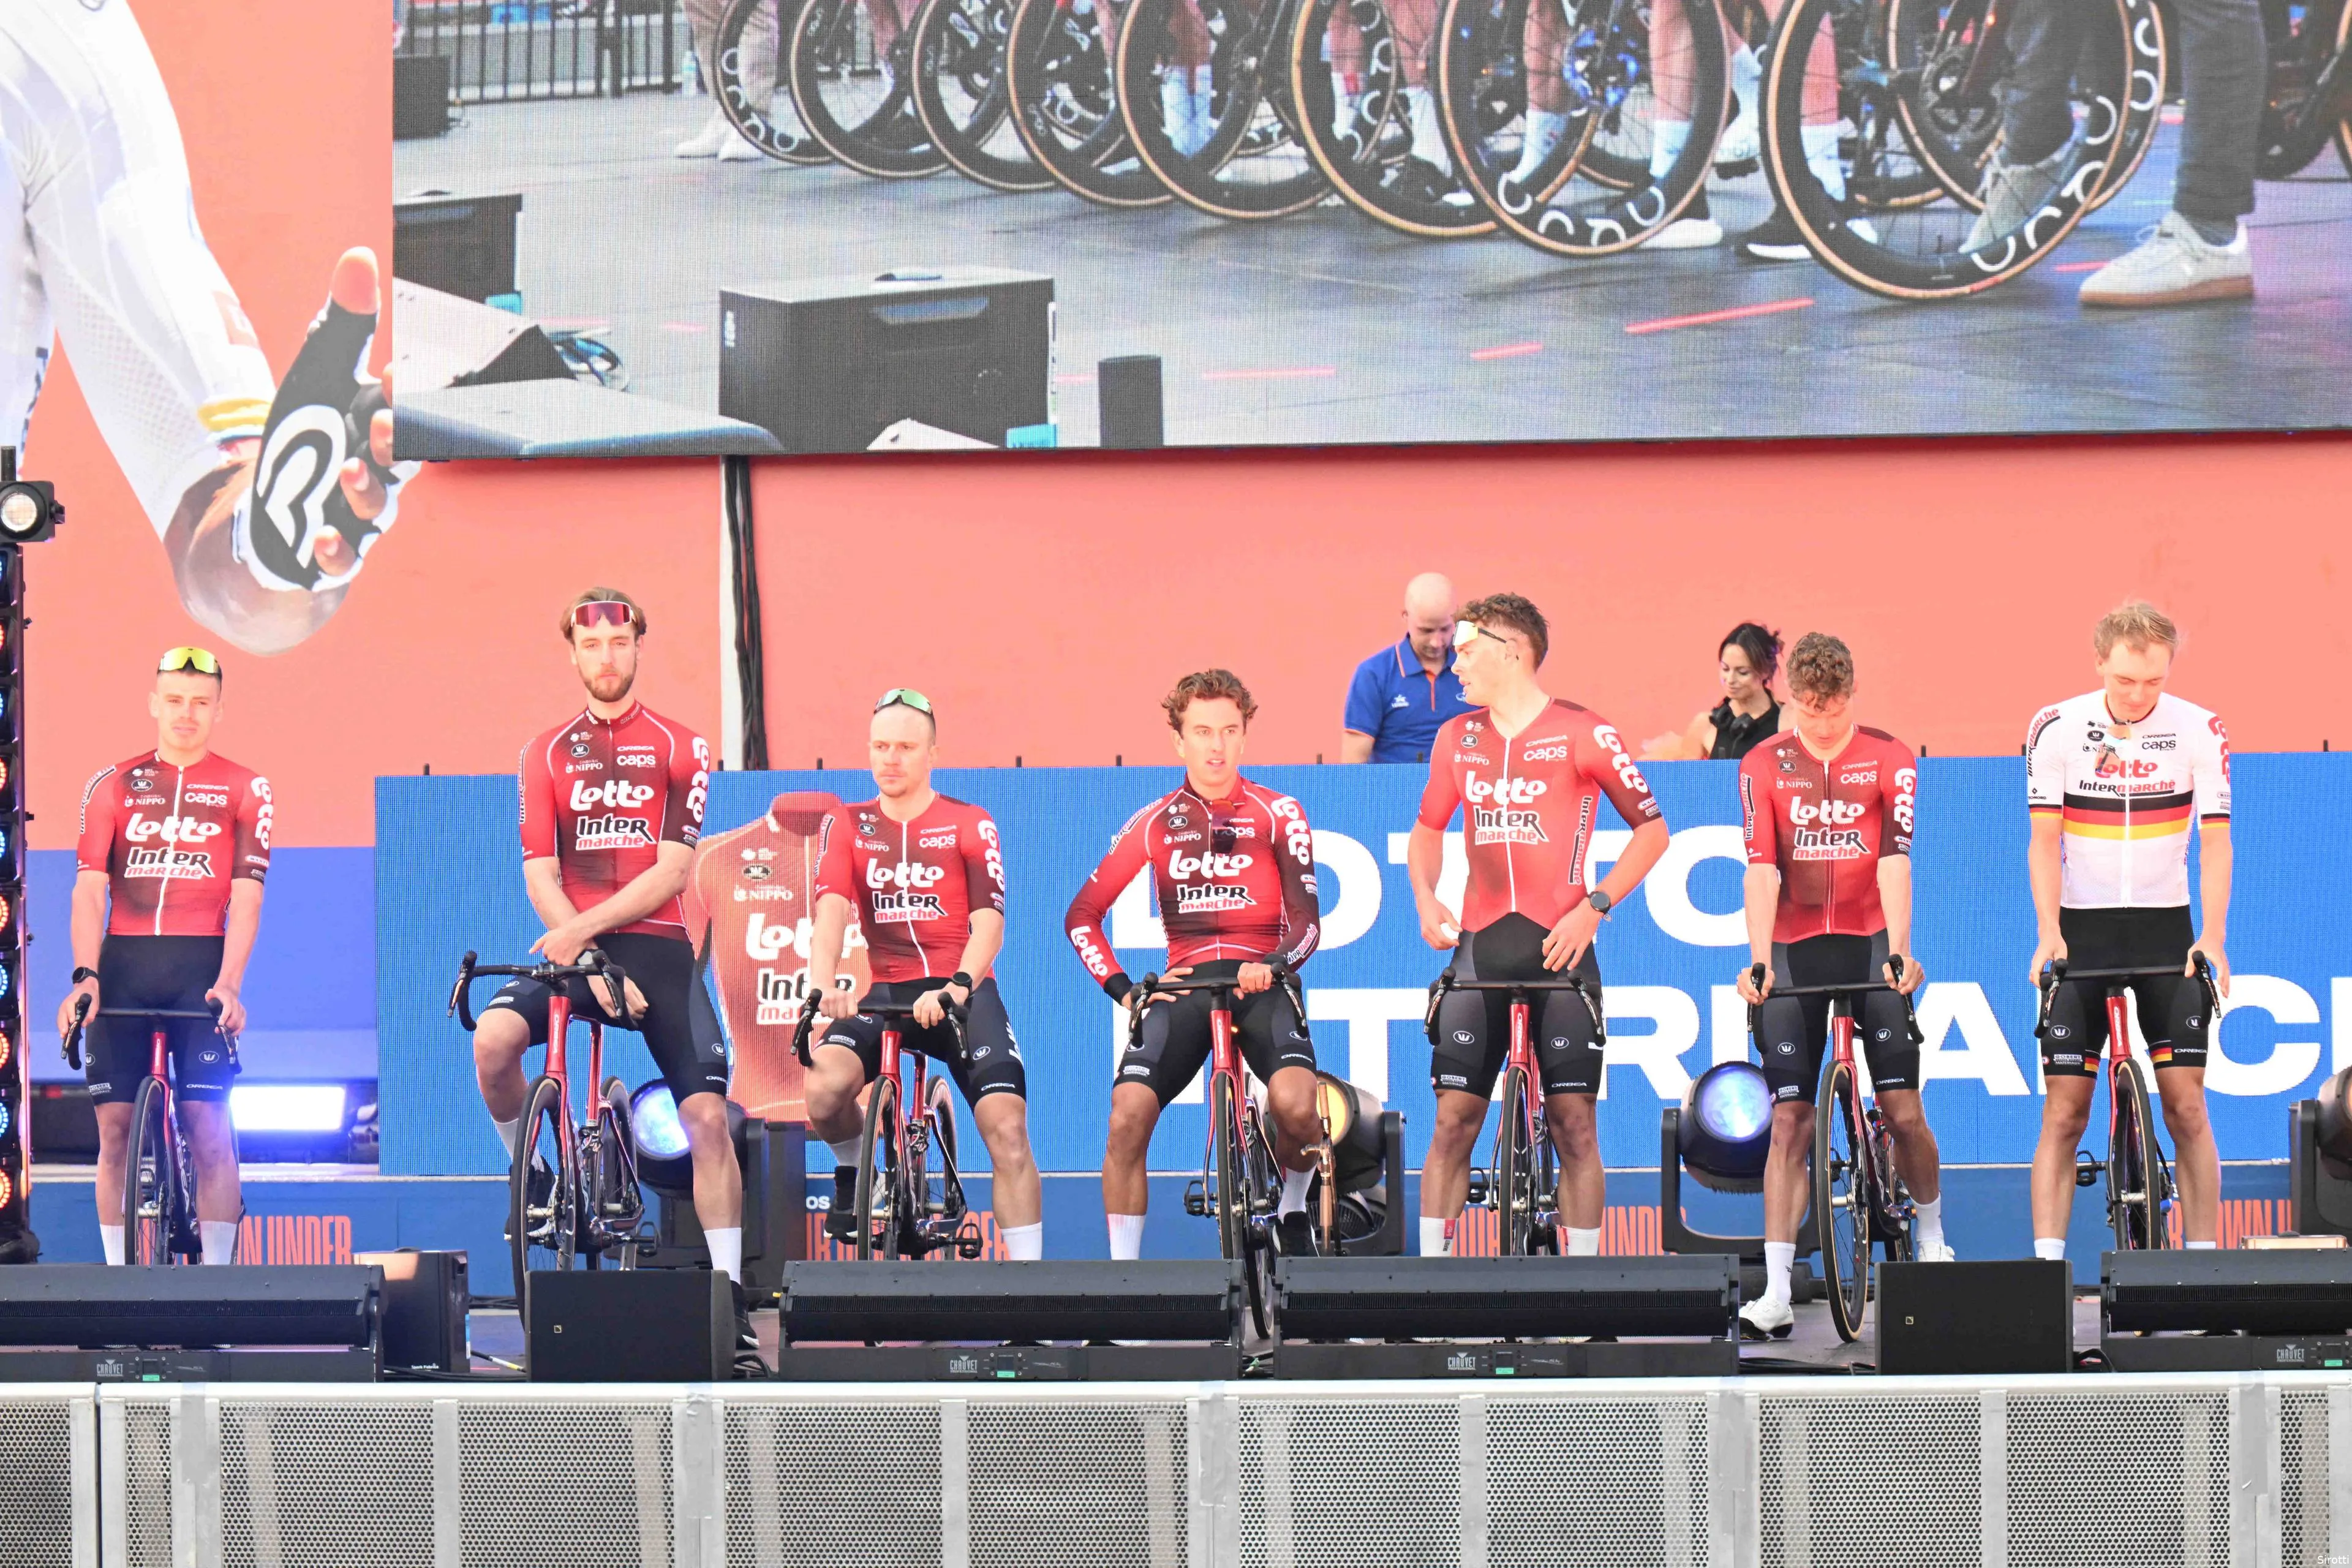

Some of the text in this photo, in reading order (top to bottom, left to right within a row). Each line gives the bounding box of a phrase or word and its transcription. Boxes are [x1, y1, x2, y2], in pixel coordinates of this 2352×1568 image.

[1523, 745, 1567, 761] caps
[2141, 740, 2176, 751] caps
[575, 763, 603, 772] NIPPO
[617, 755, 656, 767] caps
[1461, 755, 1490, 766] NIPPO
[1840, 770, 1877, 786] caps
[1464, 771, 1547, 805] Lotto
[184, 792, 227, 806] caps
[570, 780, 654, 812] Lotto
[1789, 796, 1866, 826] Lotto
[126, 813, 221, 842] Lotto
[1270, 796, 1311, 866] Lotto
[919, 834, 956, 849] caps
[1174, 833, 1201, 843] NIPPO
[864, 842, 889, 852] NIPPO
[1169, 850, 1254, 880] Lotto
[866, 858, 944, 889] Lotto
[1070, 925, 1108, 977] Lotto
[267, 1215, 352, 1265] UNDER
[2277, 1349, 2304, 1359] CHAUVET
[97, 1363, 124, 1374] CHAUVET
[950, 1360, 978, 1370] CHAUVET
[1447, 1357, 1476, 1367] CHAUVET
